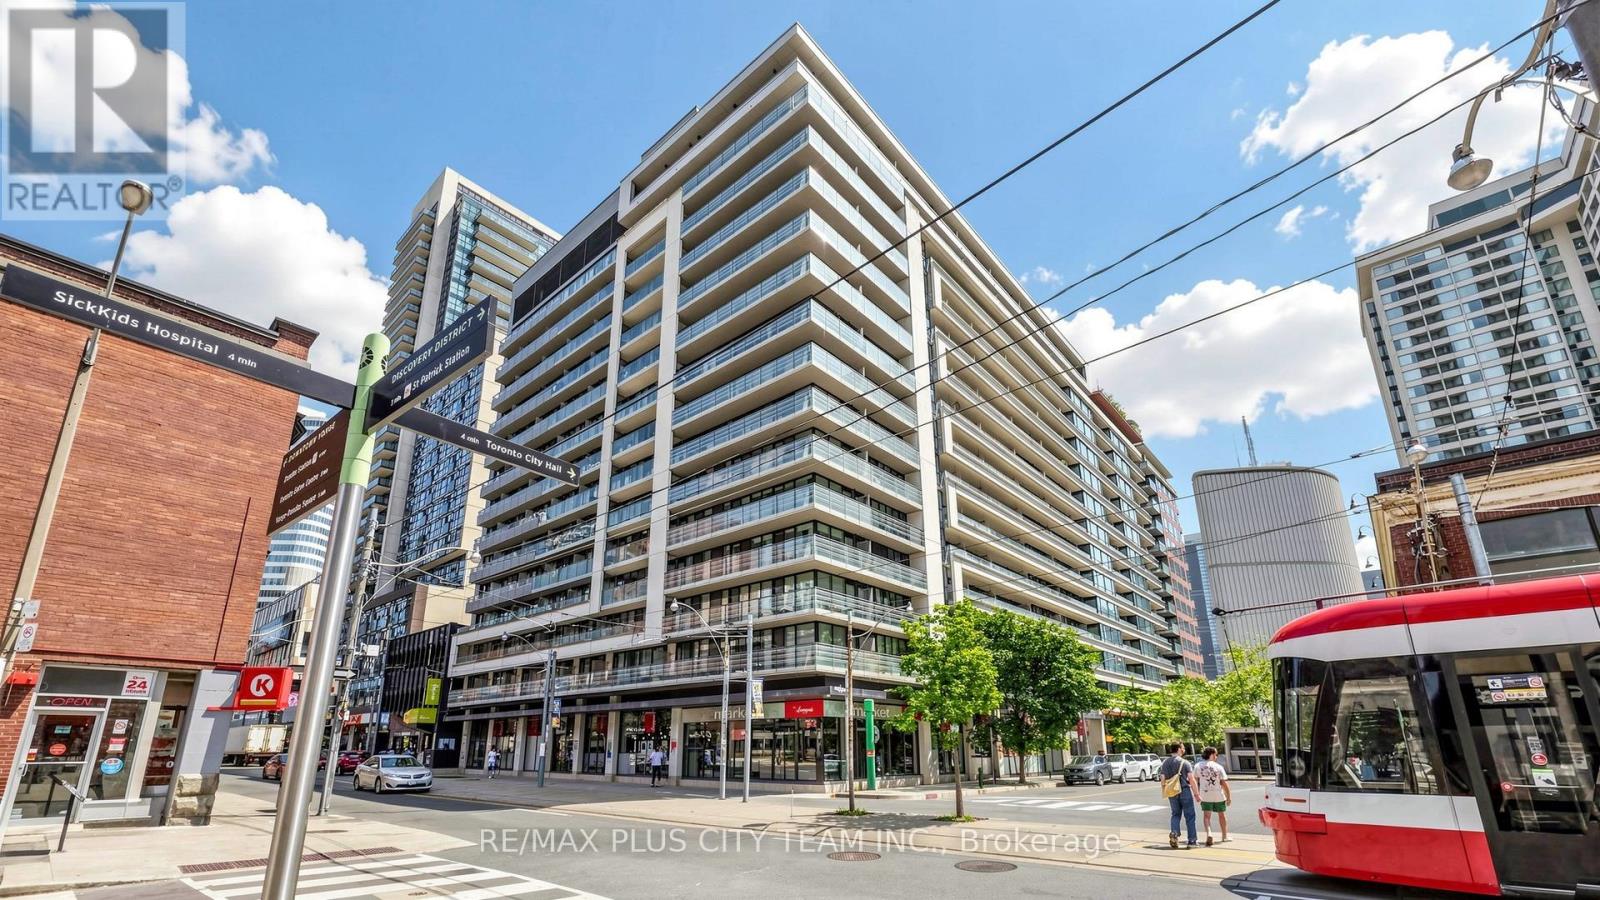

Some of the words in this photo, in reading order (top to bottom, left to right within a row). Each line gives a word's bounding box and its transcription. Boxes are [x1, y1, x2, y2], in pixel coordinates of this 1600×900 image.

[54, 291, 139, 328] SickKids
[146, 322, 218, 355] Hospital
[228, 353, 235, 361] 4
[238, 355, 257, 369] min
[392, 346, 433, 384] DISCOVERY
[434, 317, 473, 353] DISTRICT
[412, 380, 419, 391] St
[420, 363, 443, 385] Patrick
[445, 345, 470, 369] Station
[467, 436, 480, 445] min
[486, 439, 522, 459] Toronto
[525, 454, 543, 467] City
[545, 462, 562, 473] Hall
[51, 697, 92, 706] OPEN
[126, 680, 147, 690] 24
